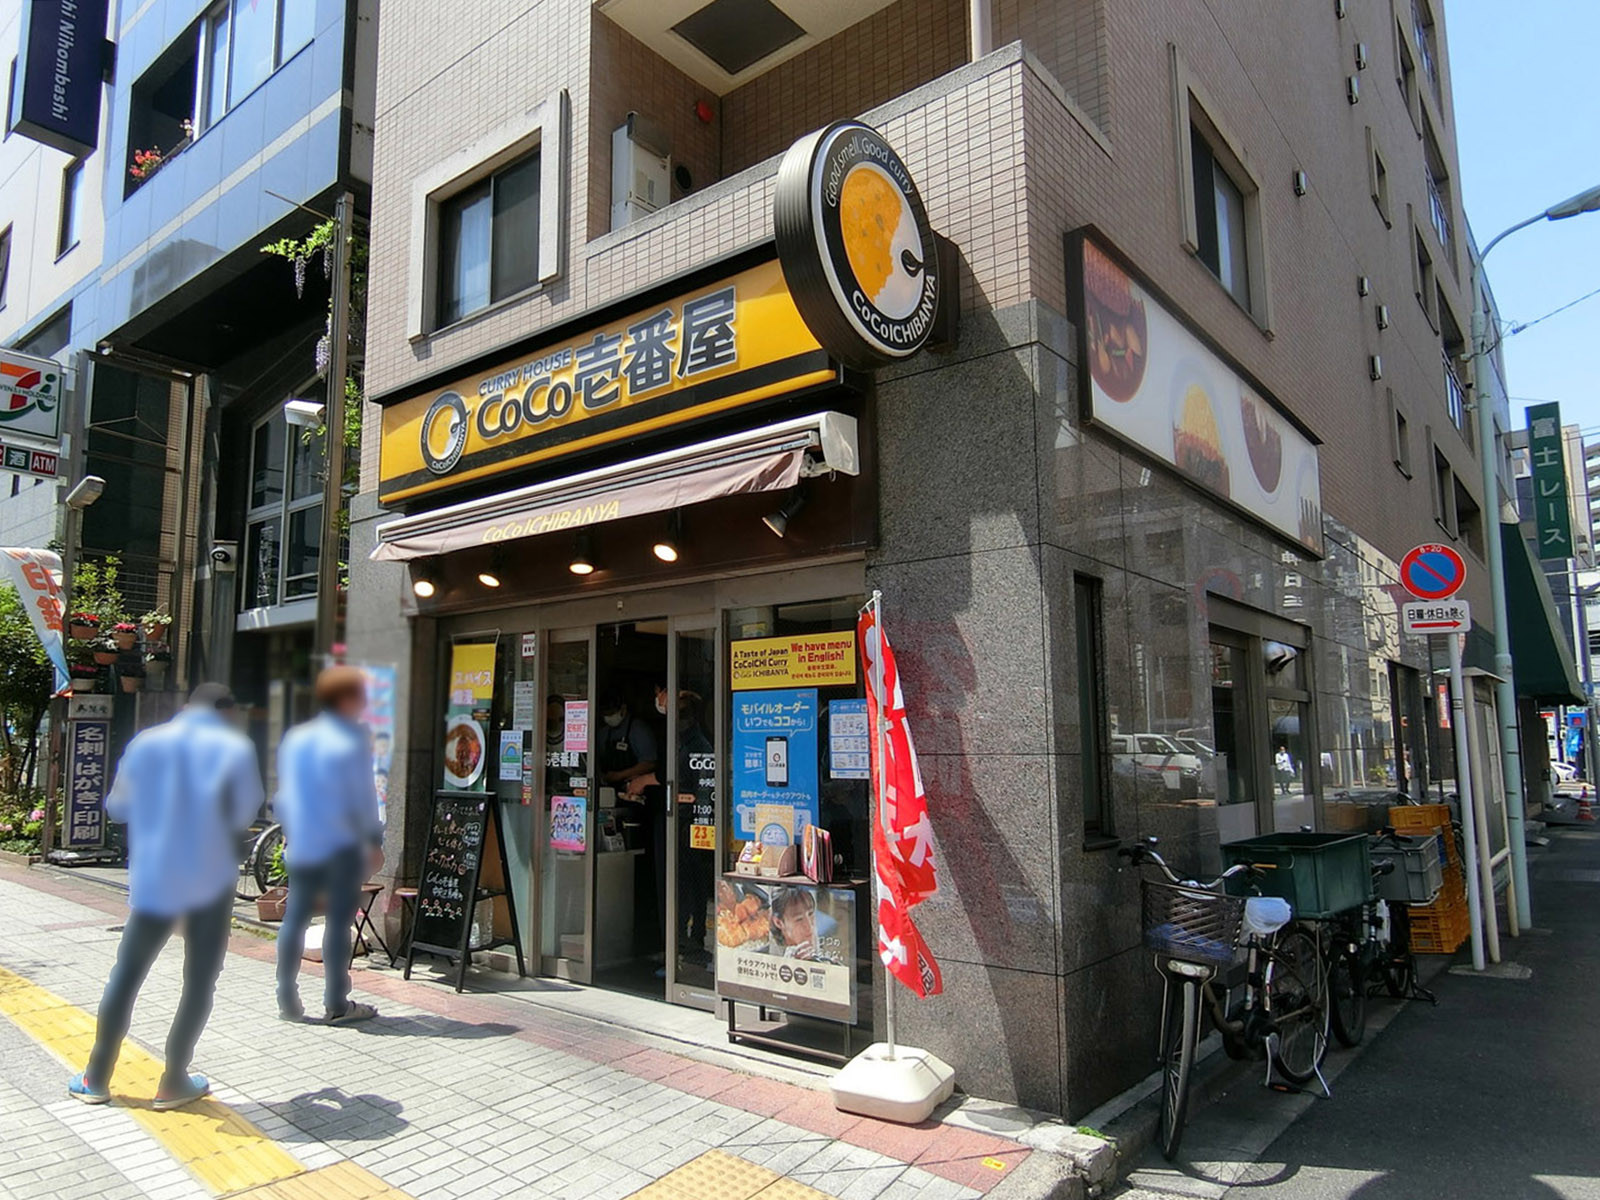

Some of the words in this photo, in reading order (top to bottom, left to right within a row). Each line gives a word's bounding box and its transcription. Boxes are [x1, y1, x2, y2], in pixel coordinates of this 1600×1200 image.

[52, 19, 75, 121] Nihombashi
[824, 156, 843, 208] Good
[861, 136, 889, 163] Good
[888, 159, 914, 195] curry
[852, 274, 937, 344] CoCoICHIBANYA
[478, 366, 520, 397] CURRY
[521, 347, 572, 381] HOUSE
[9, 449, 26, 467] 酒
[32, 455, 55, 473] ATM
[739, 650, 758, 658] Taste
[760, 649, 767, 657] of
[768, 647, 789, 657] Japan
[791, 643, 803, 653] We
[804, 642, 826, 652] have
[827, 640, 852, 650] menu
[733, 659, 767, 669] CoCoICHI
[768, 658, 788, 668] Curry
[798, 653, 806, 663] in
[807, 650, 844, 663] English!
[753, 668, 789, 678] ICHIBANYA
[741, 700, 810, 715] モバイルオーダー
[737, 957, 777, 971] テイクアウトは
